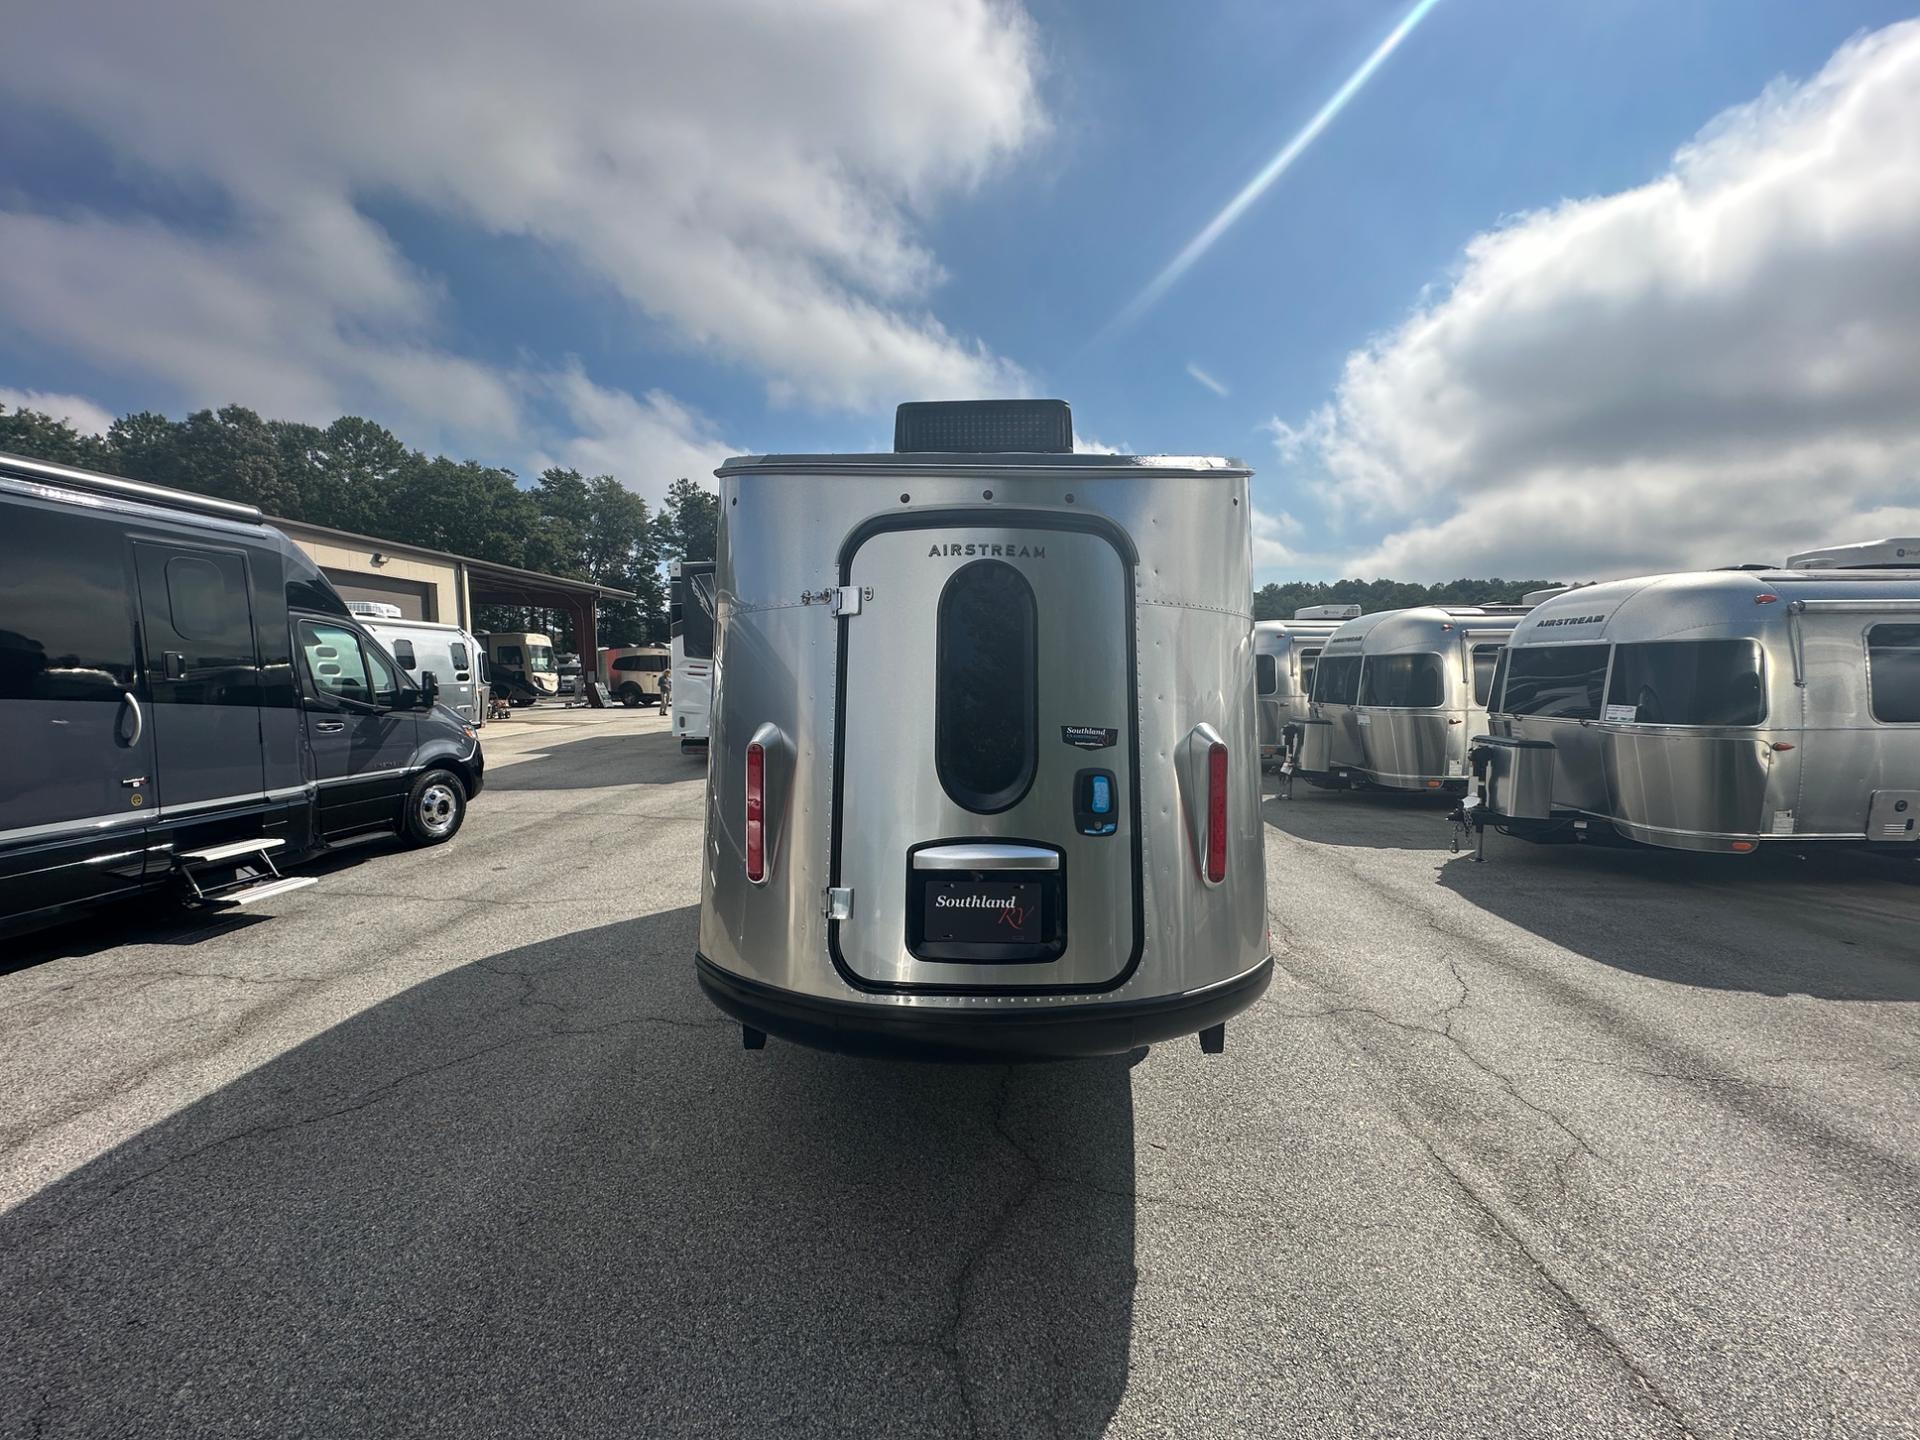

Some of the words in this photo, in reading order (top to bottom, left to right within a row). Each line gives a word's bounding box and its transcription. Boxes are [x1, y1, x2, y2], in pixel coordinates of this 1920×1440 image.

[928, 543, 1046, 559] AIRSTREAM
[1537, 615, 1605, 628] AIRSTREAM
[1066, 727, 1106, 736] Southland
[936, 895, 1017, 909] Southland
[998, 906, 1034, 930] RV
